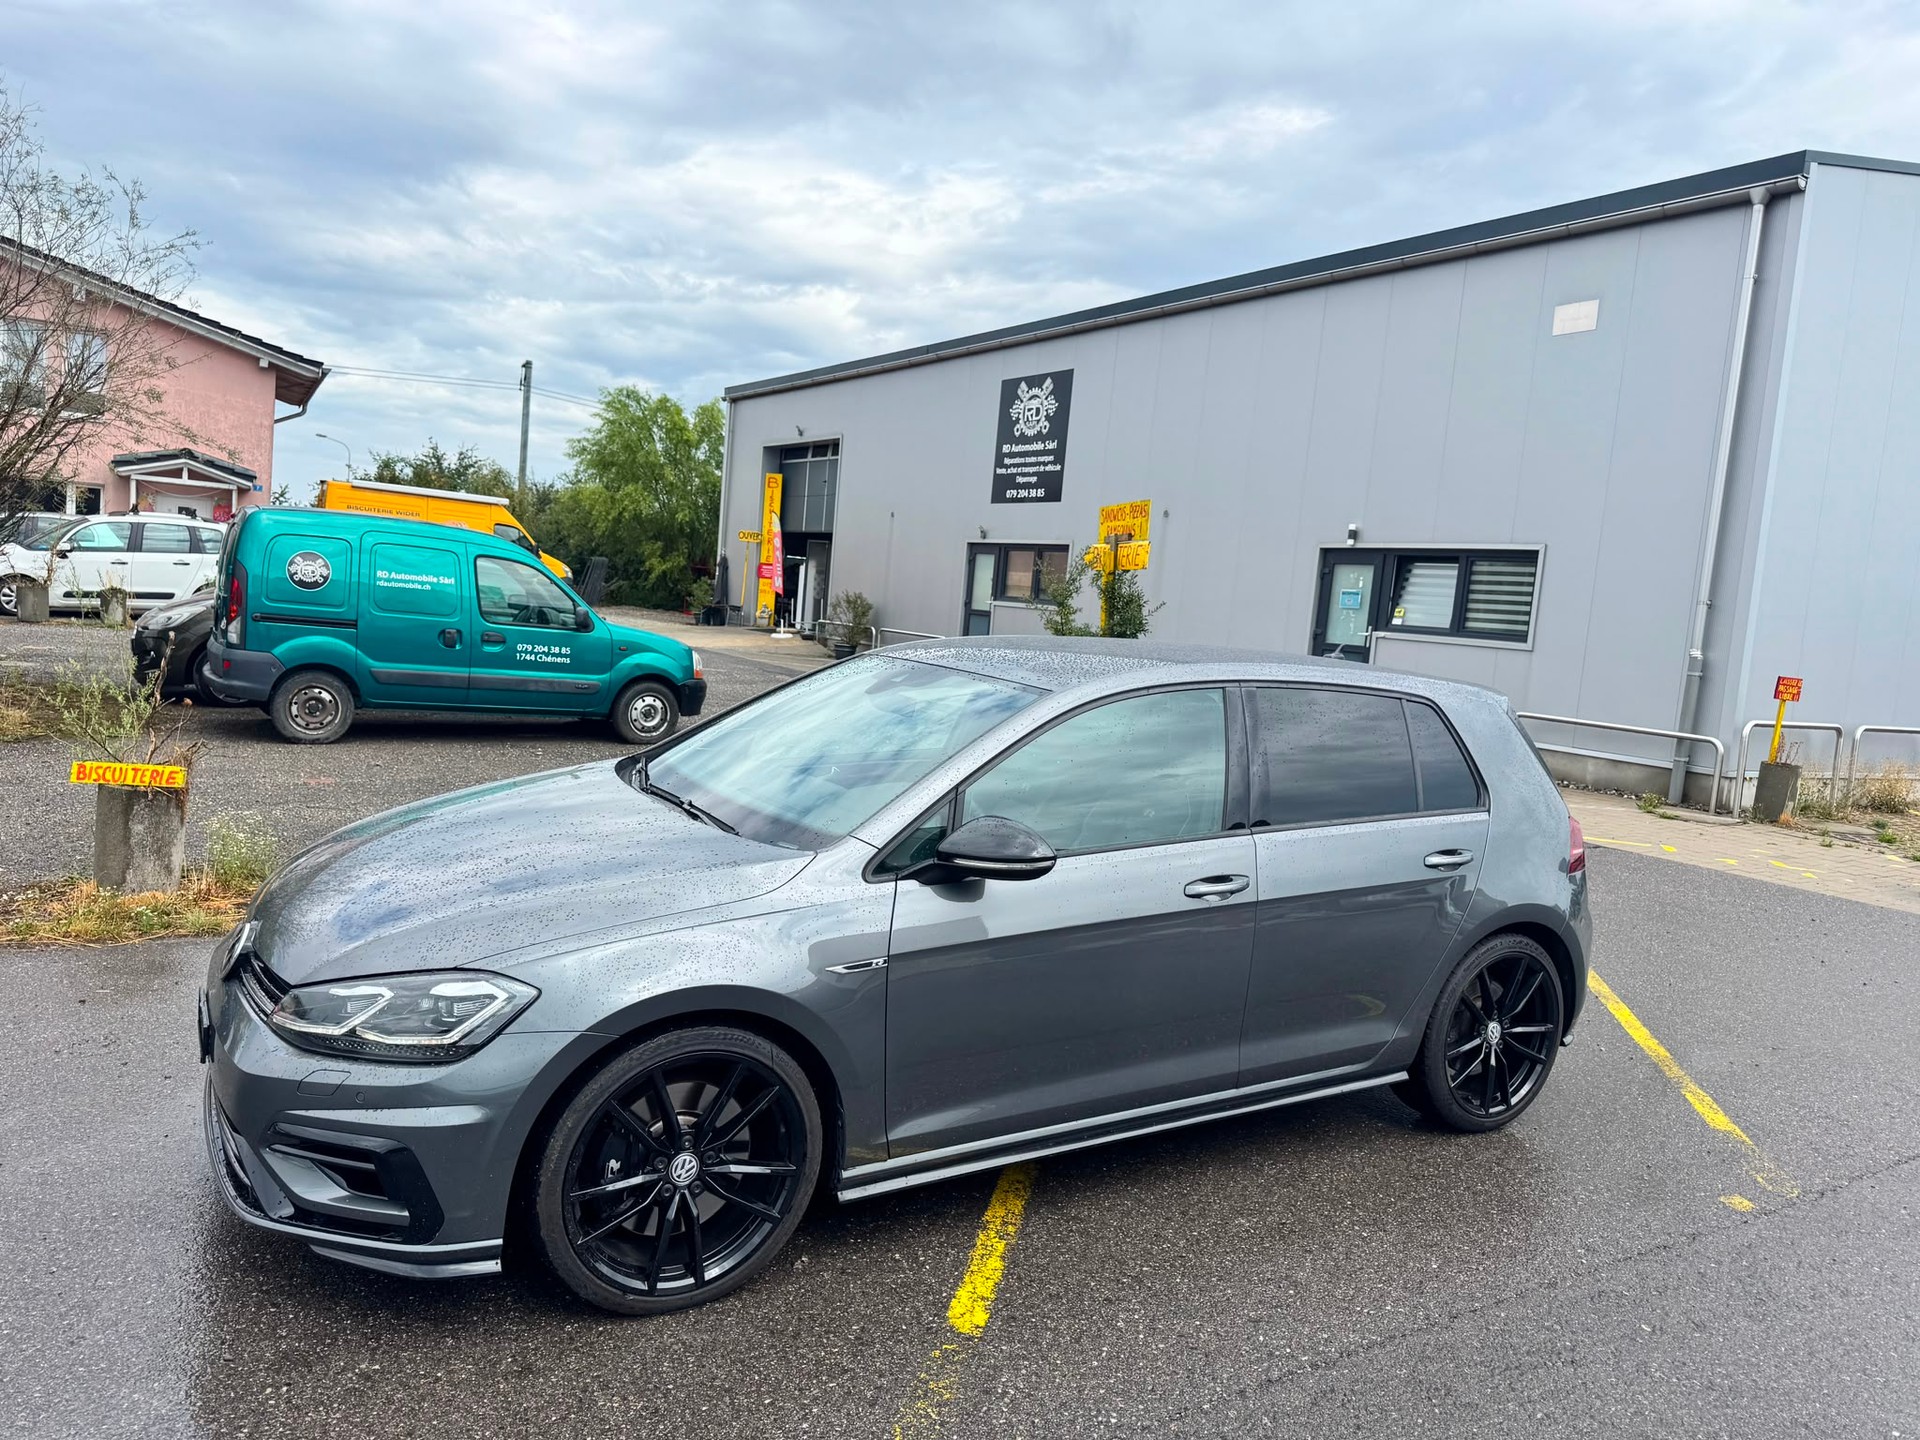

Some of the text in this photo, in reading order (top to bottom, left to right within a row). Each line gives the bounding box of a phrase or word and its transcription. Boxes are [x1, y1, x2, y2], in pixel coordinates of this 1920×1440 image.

[1024, 404, 1043, 421] RD
[1002, 444, 1011, 453] RD
[1011, 441, 1044, 452] Automobile
[1006, 488, 1045, 498] 079 204 38 85
[376, 570, 389, 579] RD
[390, 571, 438, 583] Automobile
[376, 580, 431, 590] rdautomobile.ch
[517, 643, 571, 655] 079 204 38 85
[516, 653, 571, 664] 1744 Chénens
[76, 763, 181, 786] BISCUITERIE
